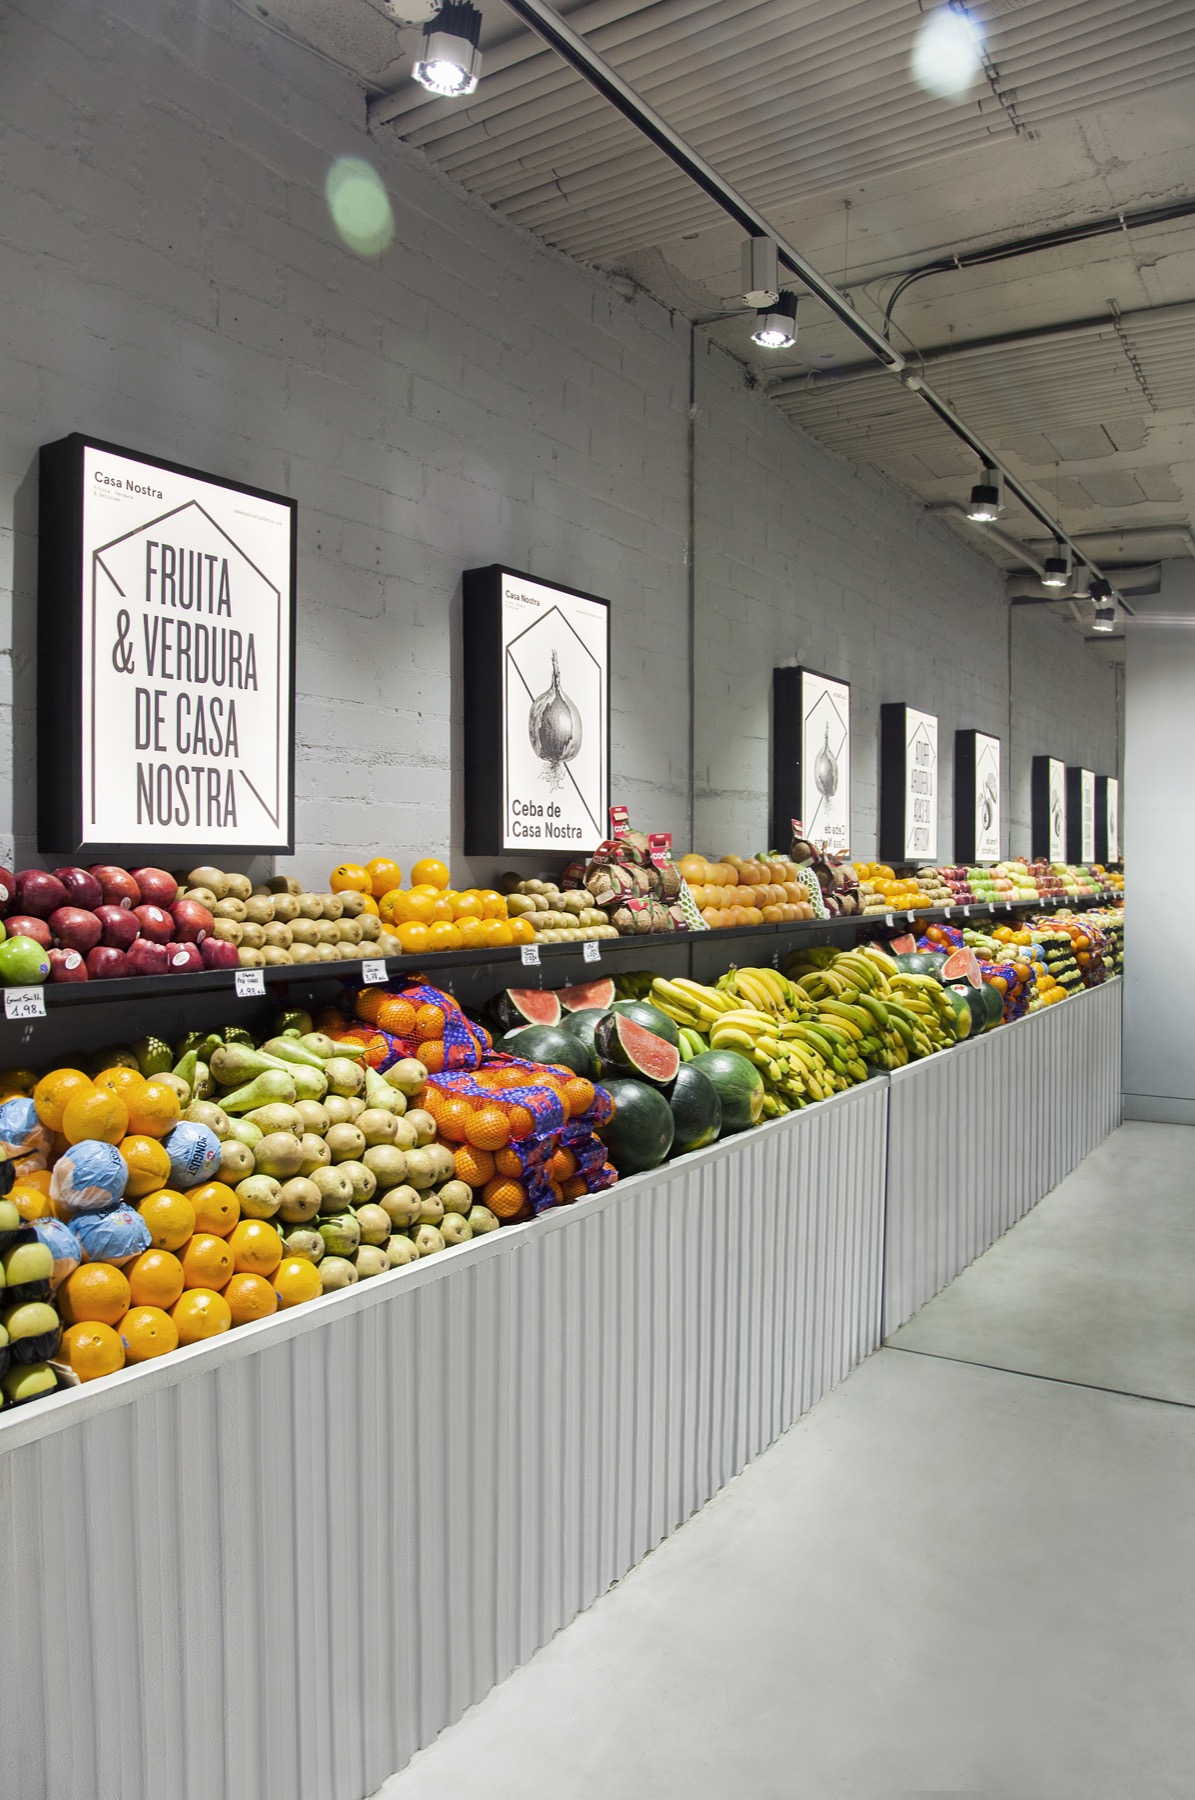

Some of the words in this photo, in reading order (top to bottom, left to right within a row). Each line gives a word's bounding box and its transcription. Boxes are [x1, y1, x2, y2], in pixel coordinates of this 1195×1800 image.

[94, 471, 122, 488] Casa
[126, 479, 163, 499] Nostra
[146, 540, 232, 618] FRUITA
[505, 590, 520, 601] Casa
[521, 594, 540, 606] Nostra
[112, 609, 135, 674] &
[143, 613, 258, 691] VERDURA
[135, 686, 167, 752] DE
[175, 692, 239, 758] CASA
[136, 762, 238, 828] NOSTRA
[512, 799, 543, 817] Ceba
[546, 801, 561, 818] de
[512, 820, 541, 837] Casa
[545, 822, 582, 839] Nostra
[11, 1004, 37, 1016] 1,98
